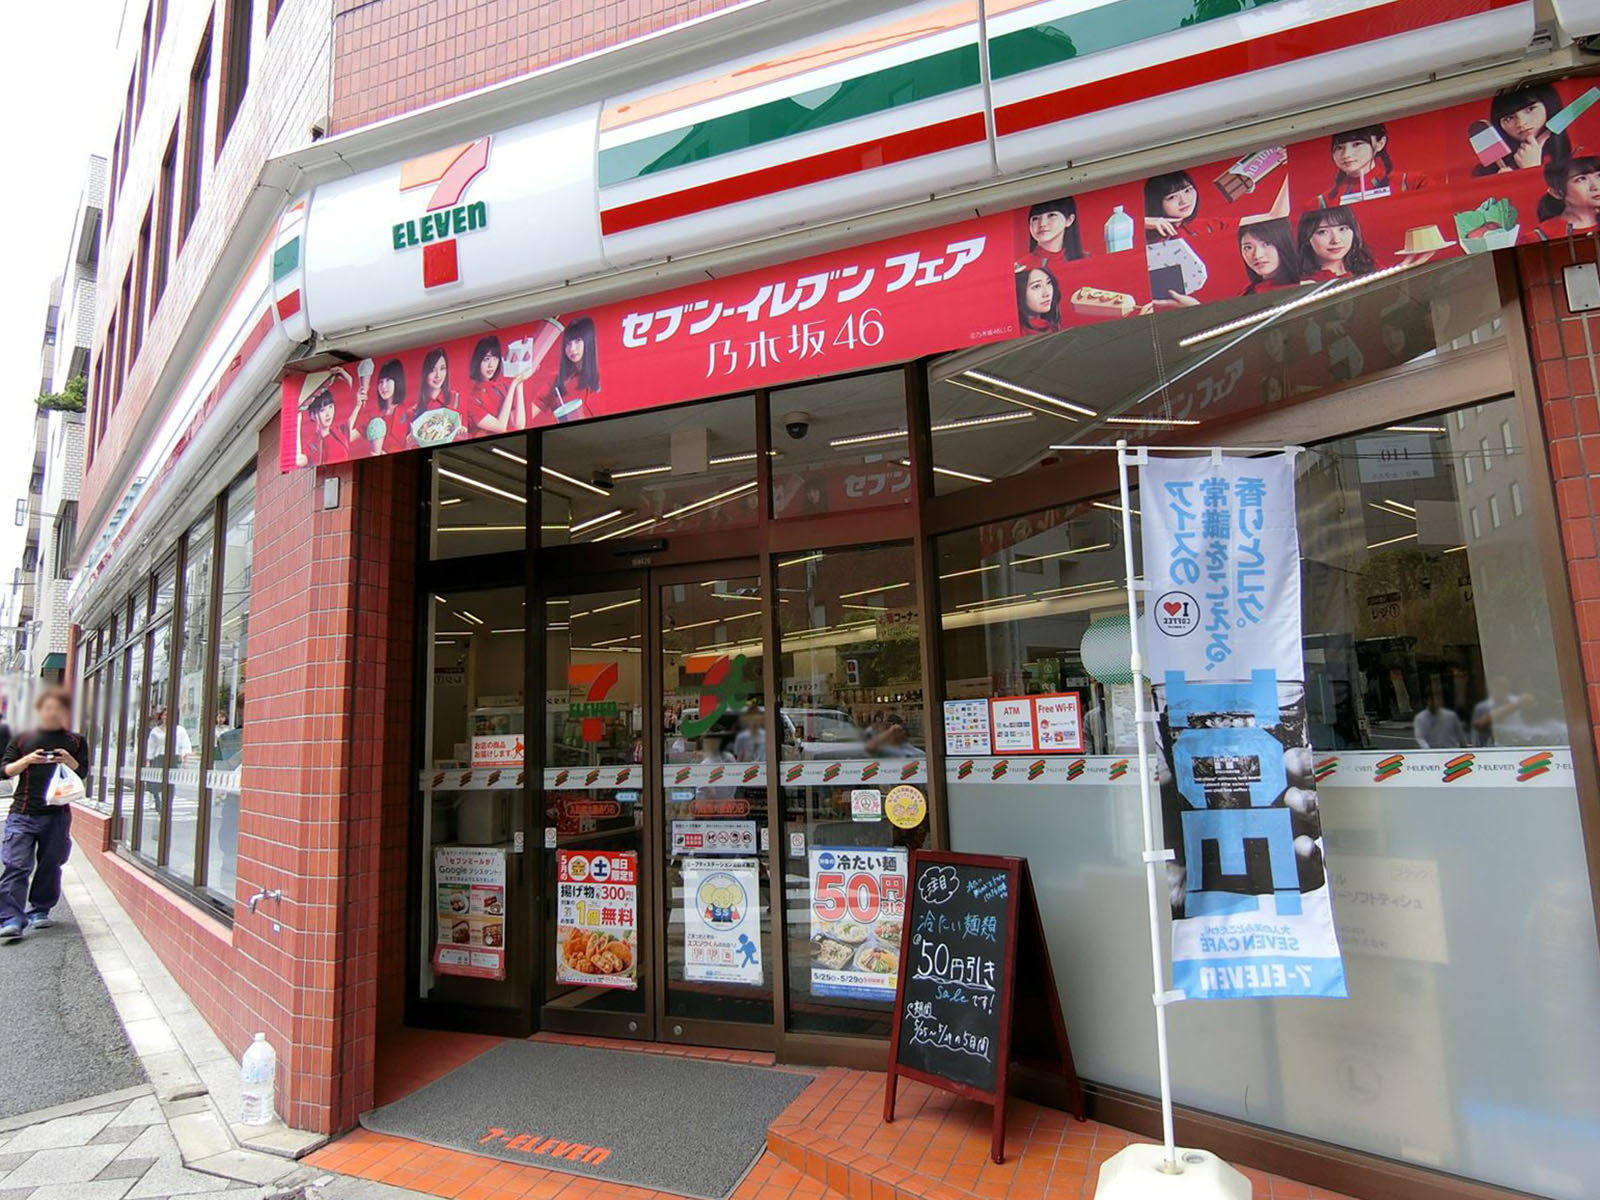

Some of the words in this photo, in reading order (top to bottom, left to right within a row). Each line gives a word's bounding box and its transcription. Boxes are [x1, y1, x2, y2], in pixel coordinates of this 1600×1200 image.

[884, 235, 986, 293] フェア
[705, 307, 885, 378] 乃木坂46
[1003, 706, 1021, 716] ATM
[1038, 703, 1054, 714] Free
[1055, 702, 1076, 713] Wi-Fi
[439, 865, 467, 876] Google
[571, 859, 585, 876] 金
[593, 860, 608, 877] 土
[836, 854, 897, 872] 冷たい麺
[561, 884, 595, 899] 揚げ物
[601, 907, 633, 926] 無料
[917, 910, 998, 943] 冷たい麺類
[935, 985, 969, 1003] Sale
